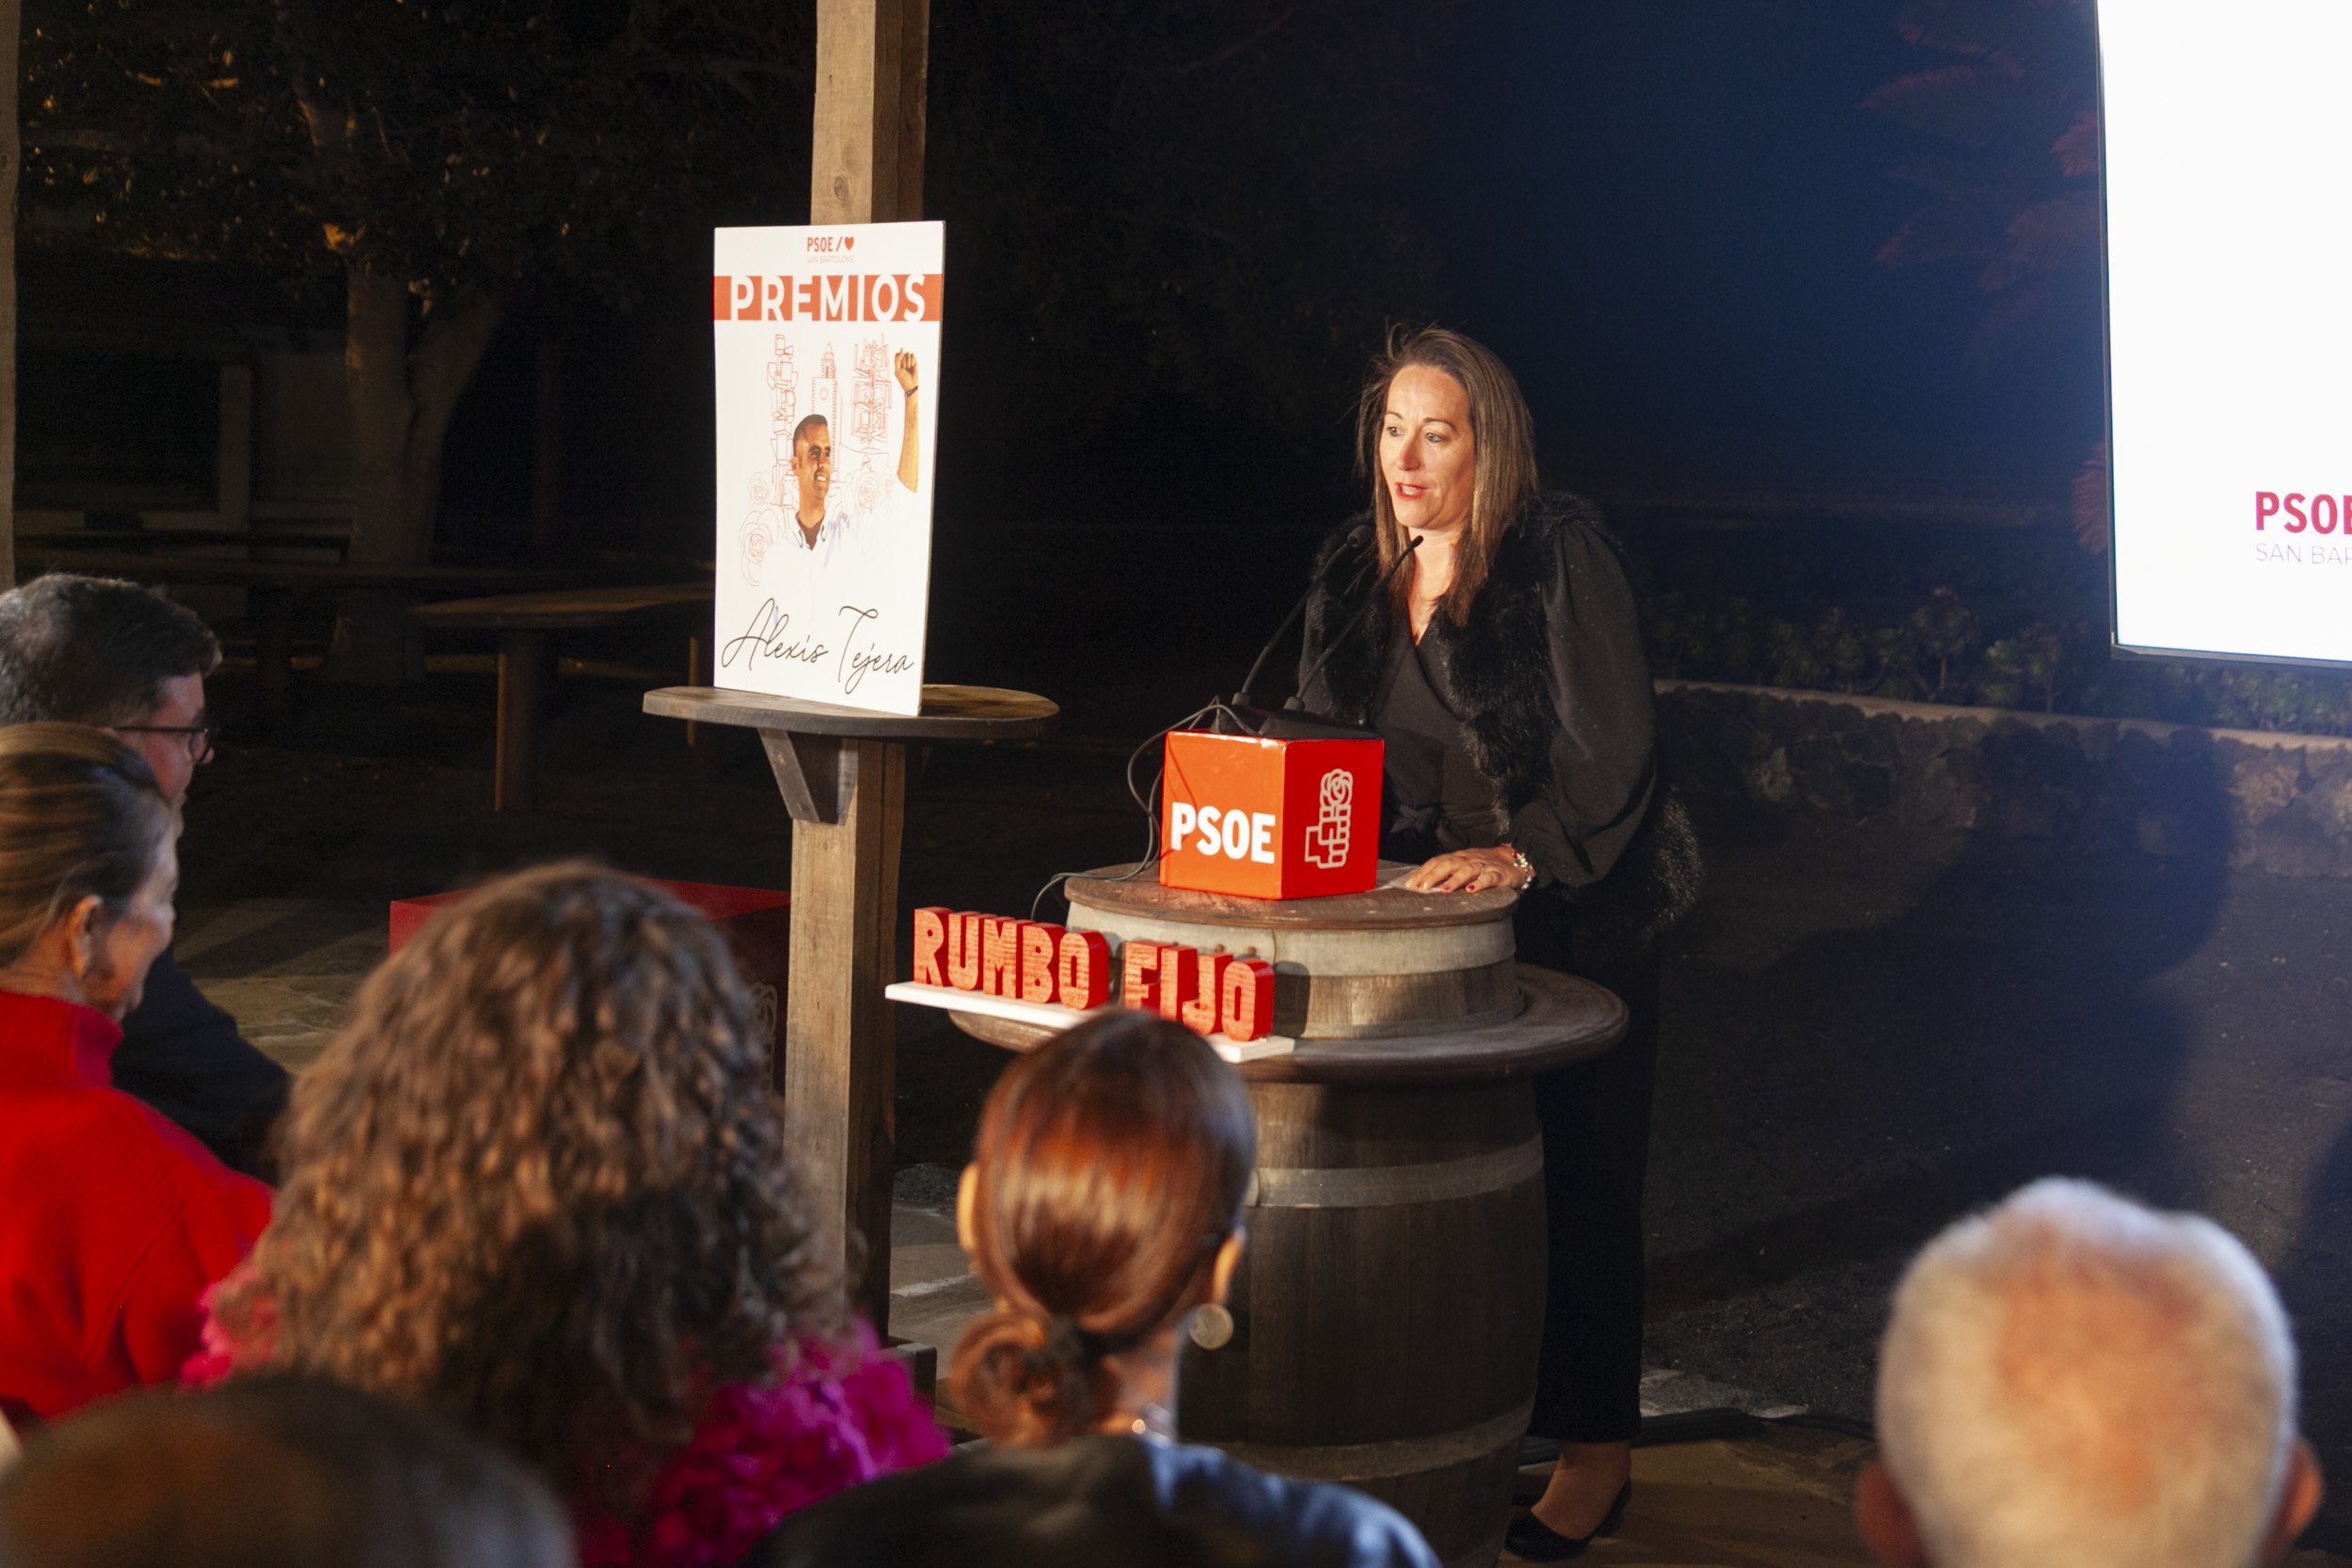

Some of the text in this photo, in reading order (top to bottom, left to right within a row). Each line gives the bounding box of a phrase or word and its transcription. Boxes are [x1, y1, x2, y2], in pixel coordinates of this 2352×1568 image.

[806, 236, 834, 253] PSOE
[730, 273, 926, 323] PREMIOS
[2255, 542, 2302, 562] SAN
[721, 597, 915, 695] Alexis Tejera
[1170, 800, 1277, 864] PSOE
[914, 907, 1273, 1042] RUMBO FIJO
